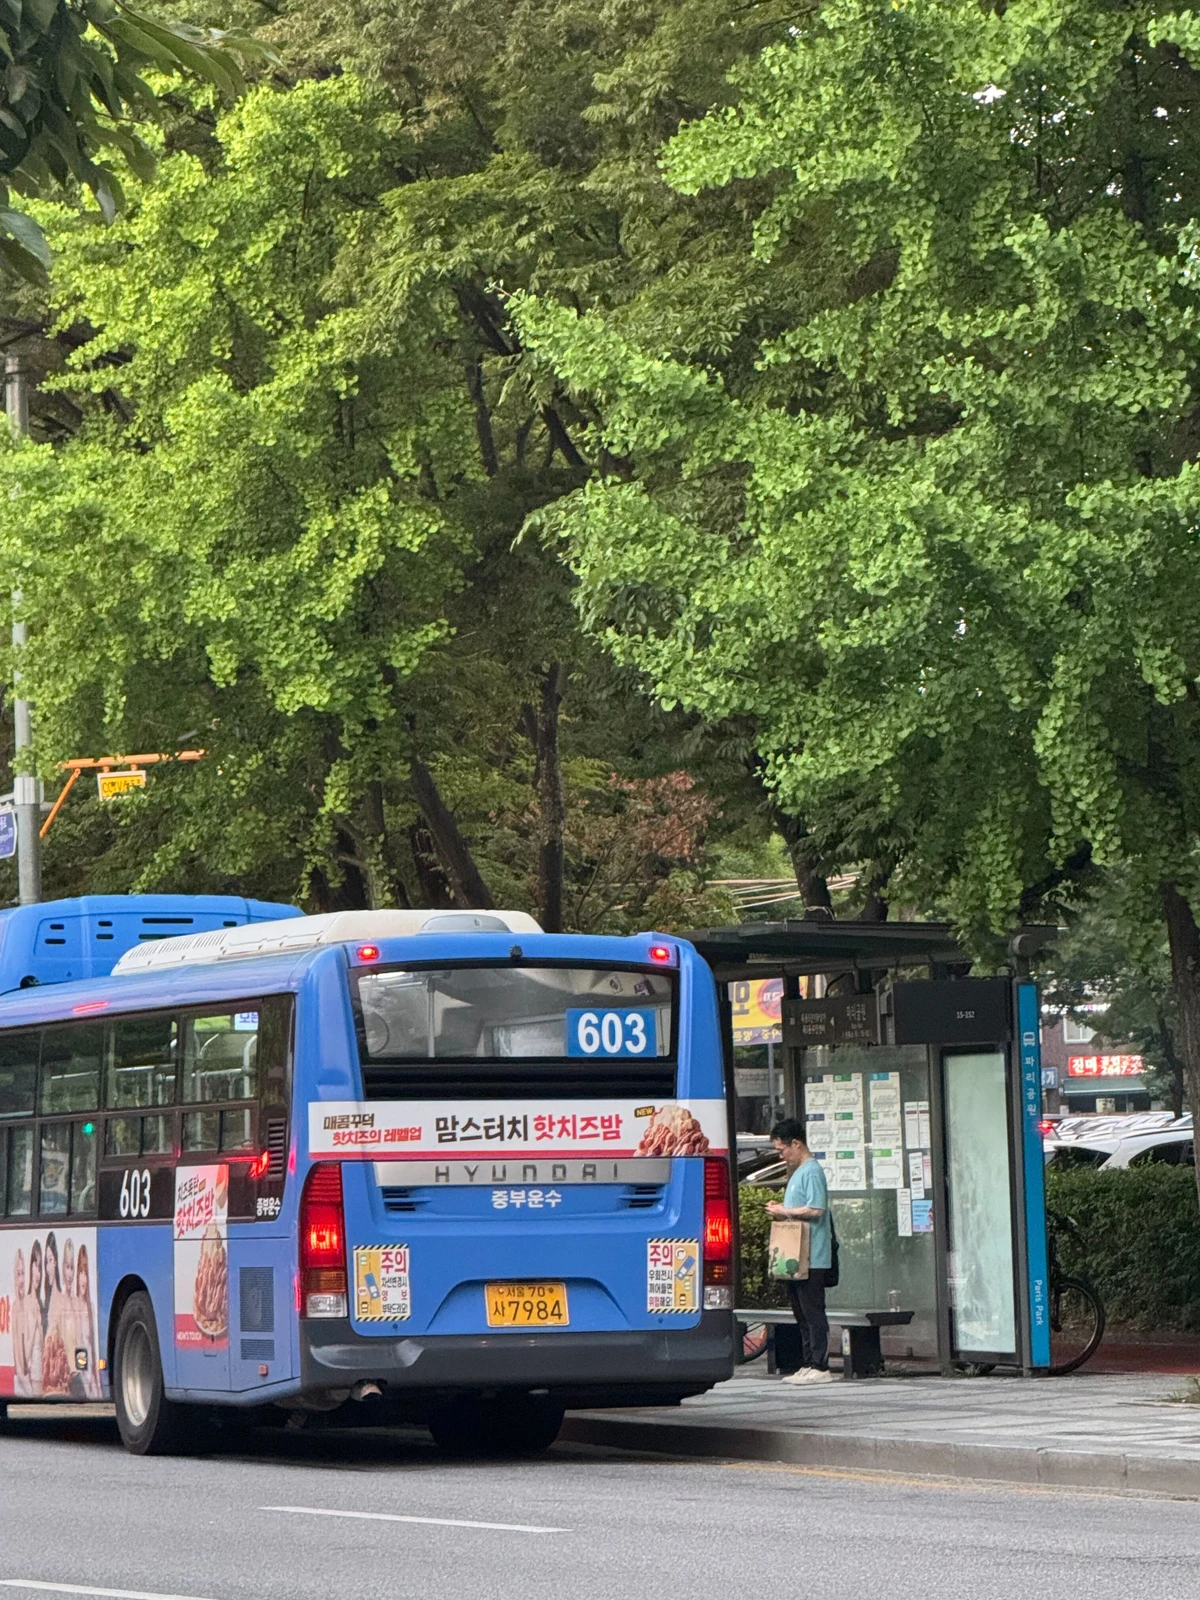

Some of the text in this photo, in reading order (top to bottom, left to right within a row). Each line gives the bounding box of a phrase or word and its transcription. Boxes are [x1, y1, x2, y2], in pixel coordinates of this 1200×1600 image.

[578, 1012, 647, 1054] 603
[1025, 1056, 1037, 1116] 파리공원
[323, 1113, 375, 1130] 매콤꾸덕
[435, 1114, 623, 1143] 맘스터치 핫치즈밤
[332, 1126, 422, 1146] 핫치즈의 레벨업
[435, 1163, 618, 1183] HYUNDAI
[120, 1169, 151, 1217] 603
[491, 1190, 562, 1209] 중부운수
[176, 1188, 214, 1238] 핫치즈밤
[256, 1197, 281, 1216] 중부운수
[381, 1250, 407, 1274] 주의
[649, 1245, 673, 1267] 주의
[649, 1270, 673, 1281] 우회전시
[1034, 1280, 1044, 1326] Paris Park
